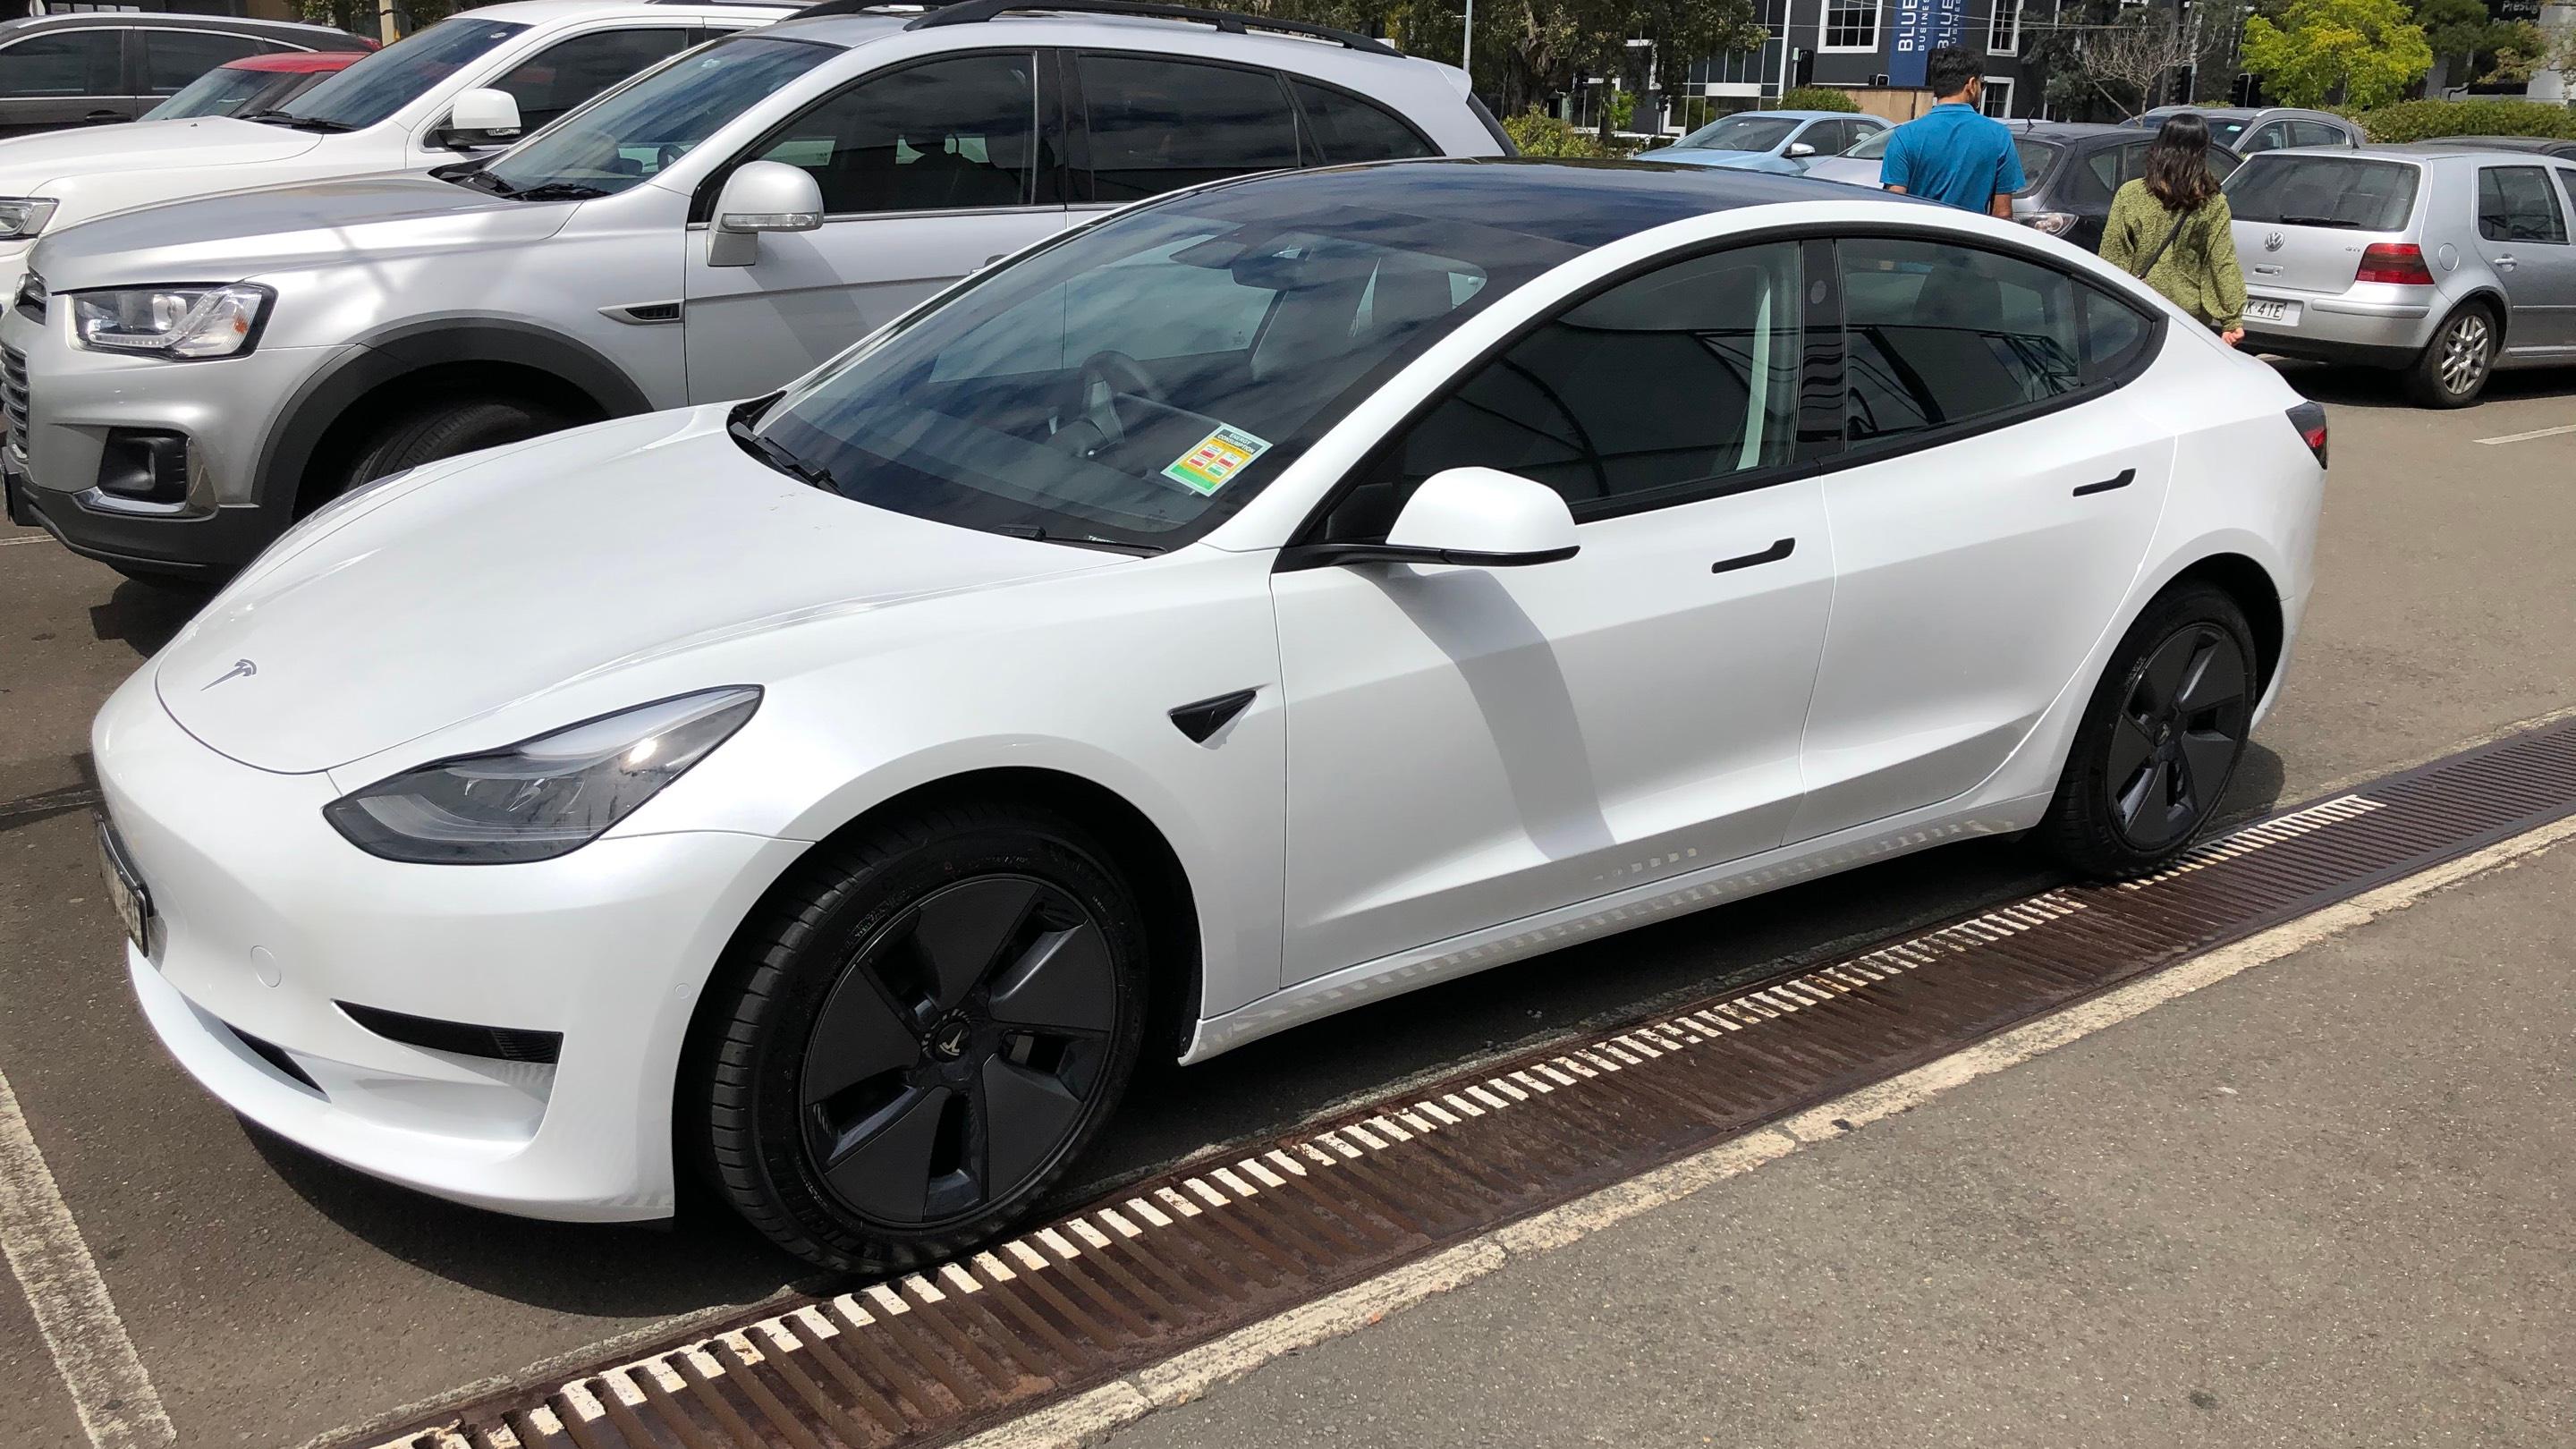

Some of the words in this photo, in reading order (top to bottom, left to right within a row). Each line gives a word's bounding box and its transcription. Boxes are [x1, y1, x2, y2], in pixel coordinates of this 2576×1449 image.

[1898, 0, 1918, 51] BLUE
[1937, 0, 1953, 49] BLUE
[1217, 434, 1256, 453] CONSUMPTION
[1229, 433, 1252, 445] ENERGY
